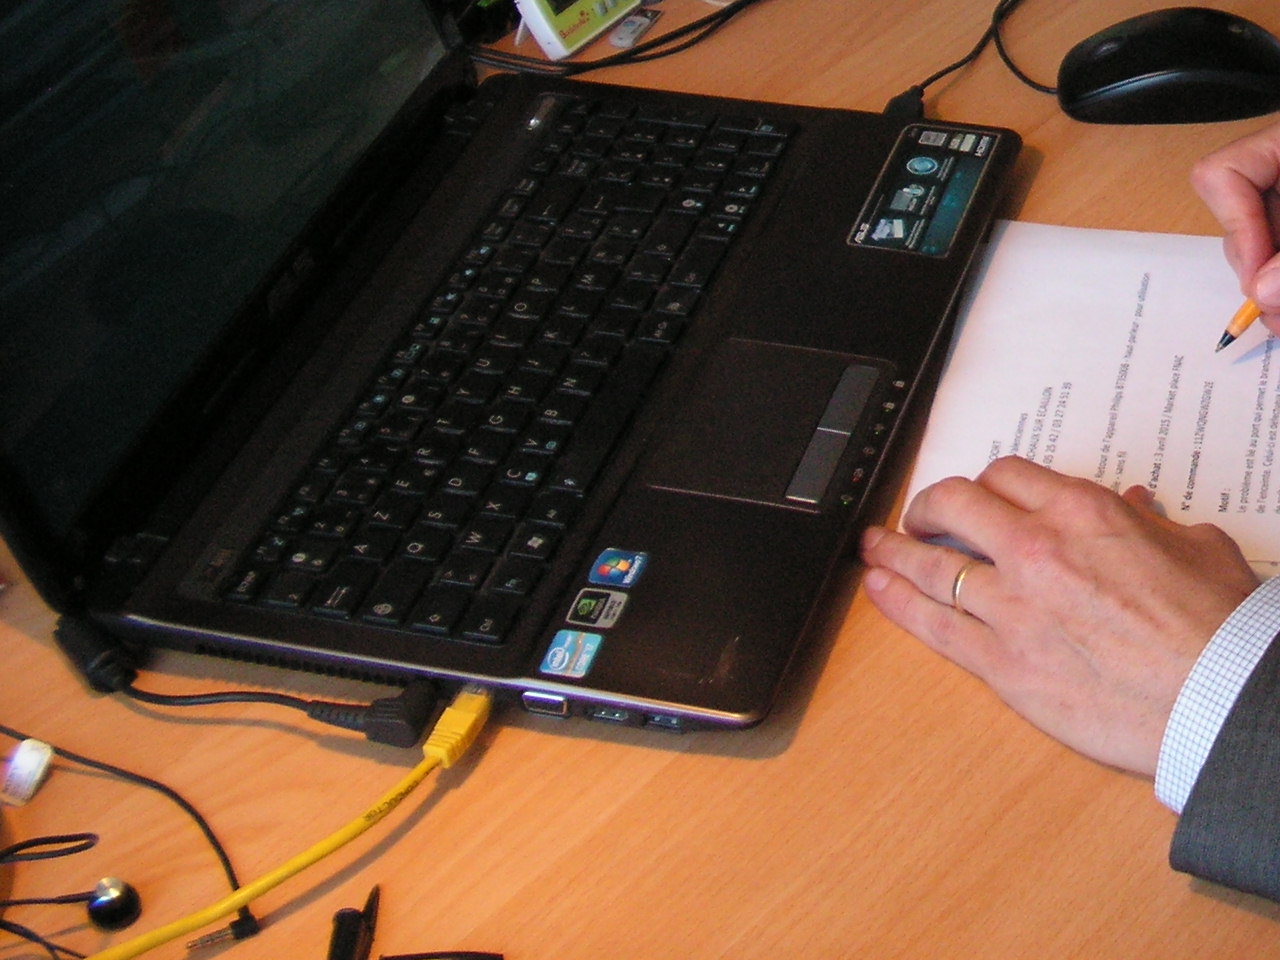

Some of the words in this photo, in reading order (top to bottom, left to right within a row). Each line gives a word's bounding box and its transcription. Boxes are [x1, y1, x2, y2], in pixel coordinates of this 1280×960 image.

[1171, 354, 1184, 371] FNAC
[1260, 338, 1276, 378] branchement
[1169, 372, 1180, 389] place
[1163, 390, 1176, 413] Market
[1255, 387, 1265, 410] permet
[1054, 408, 1063, 418] 27
[1253, 411, 1262, 422] qui
[1032, 418, 1043, 431] SUR
[1051, 419, 1062, 428] 03
[1158, 419, 1170, 436] 2015
[1250, 423, 1260, 438] port
[1009, 412, 1028, 455] alenciennes
[1048, 433, 1058, 442] 42
[1157, 436, 1166, 451] avril
[1249, 439, 1257, 447] au
[1093, 454, 1107, 478] Retour
[1100, 444, 1110, 453] de
[1115, 459, 1125, 475] sans
[1186, 450, 1200, 489] commande
[1245, 458, 1254, 469] est
[1147, 462, 1161, 489] d'achat
[1255, 504, 1265, 513] de
[1268, 430, 1277, 440] est
[1183, 490, 1193, 500] de
[1217, 492, 1229, 512] Motif
